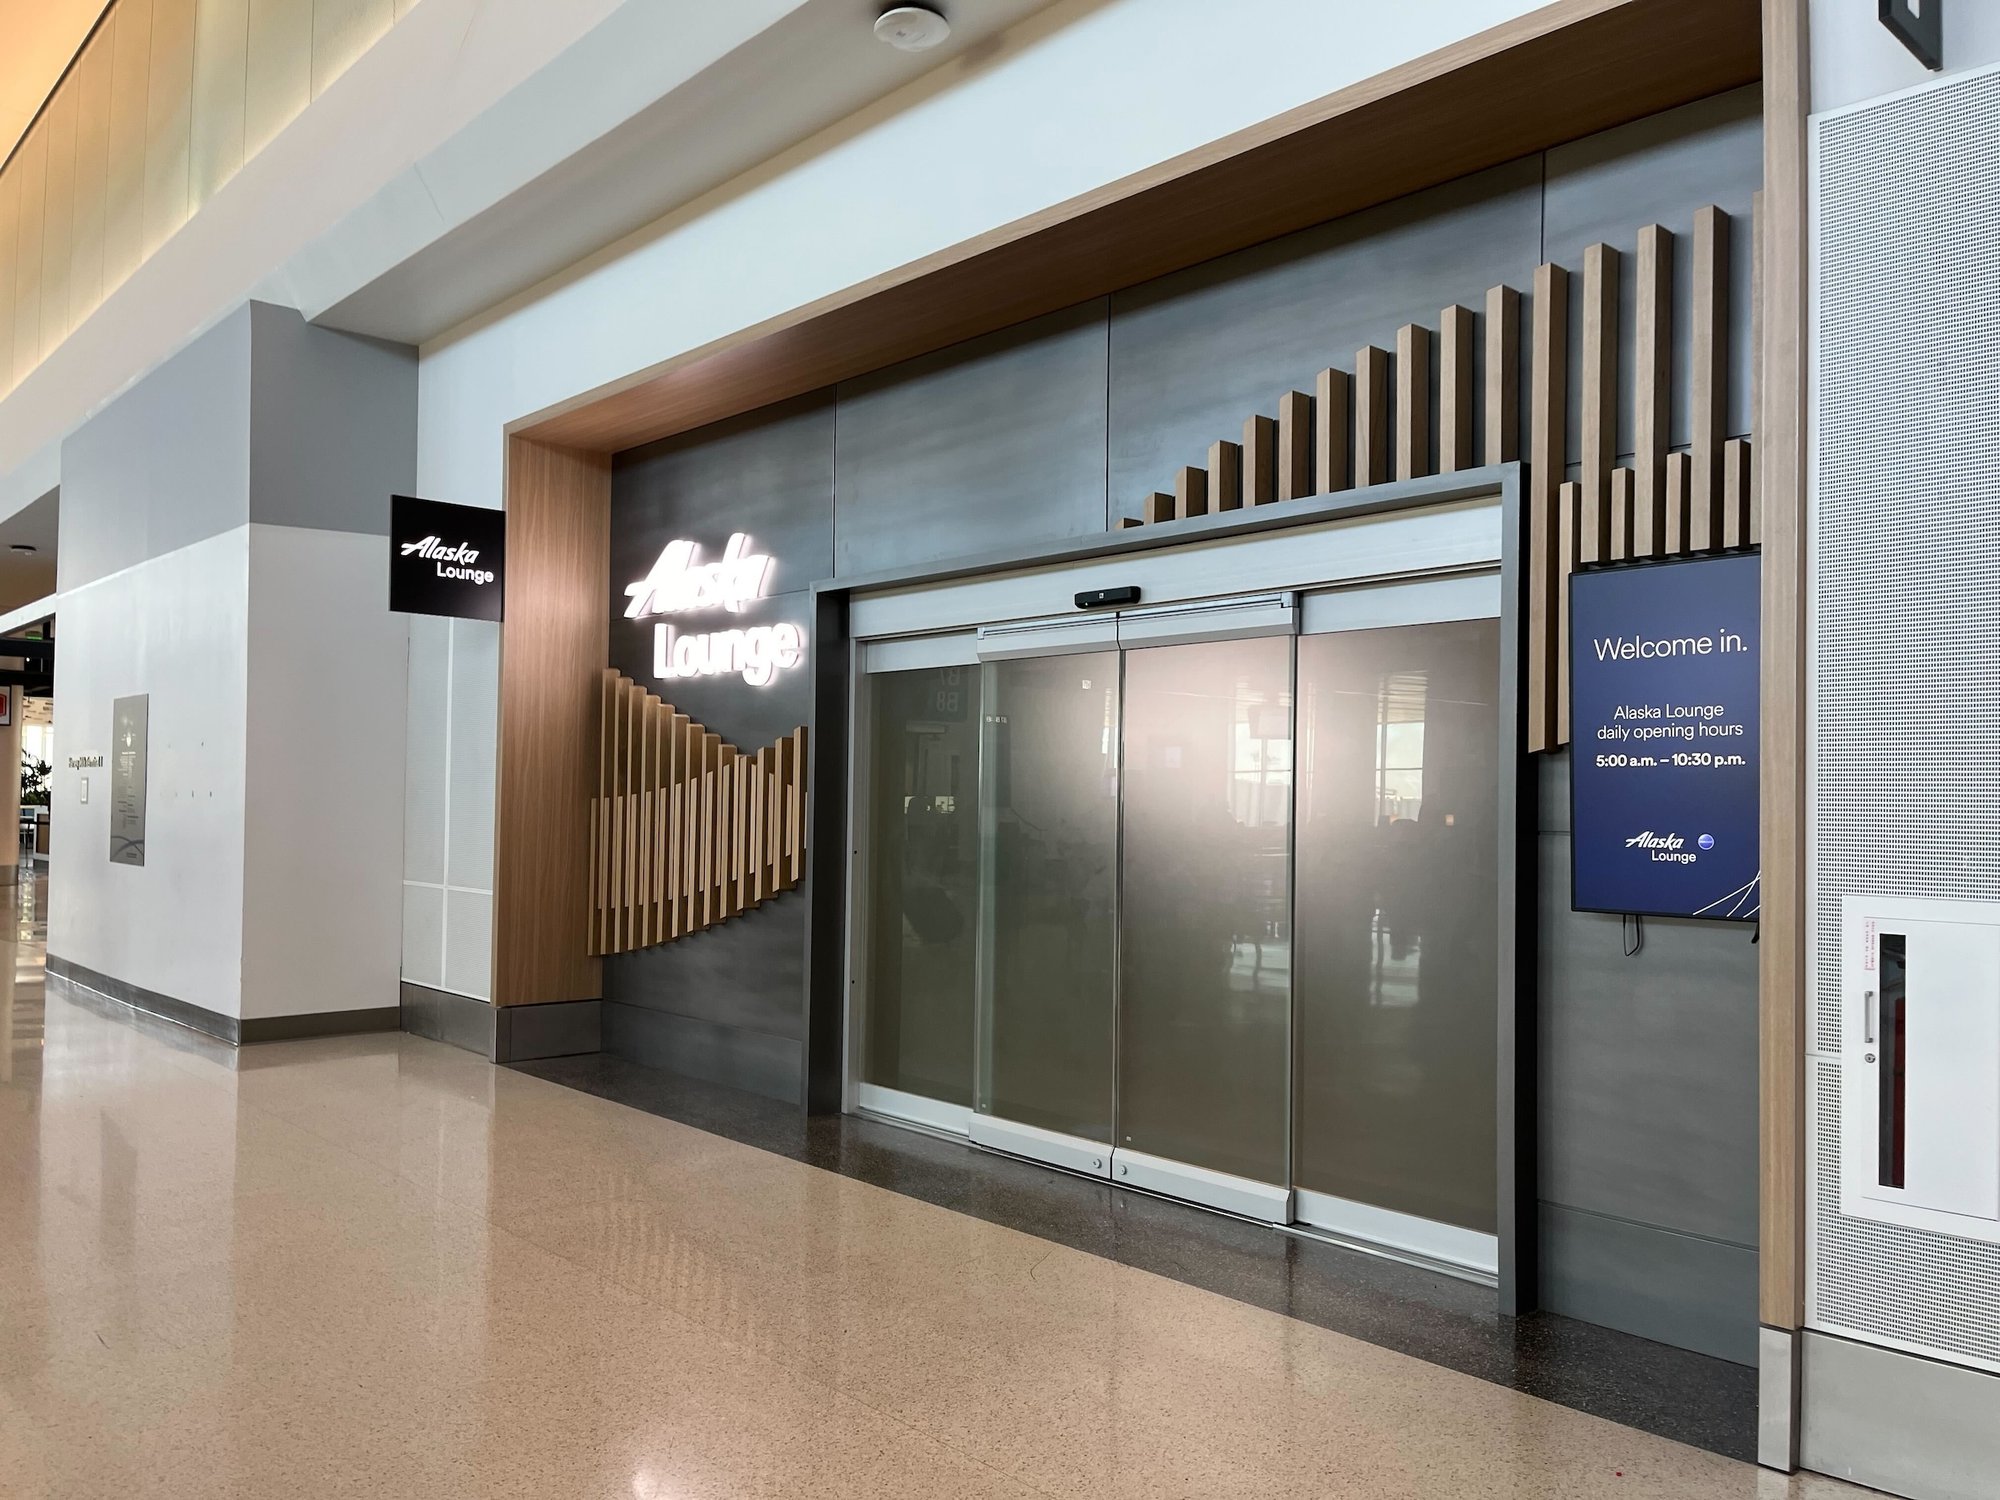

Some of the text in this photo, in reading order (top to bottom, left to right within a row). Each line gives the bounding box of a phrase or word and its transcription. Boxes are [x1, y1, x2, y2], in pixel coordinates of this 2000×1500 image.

[401, 536, 479, 565] Alaska
[437, 561, 494, 585] Lounge
[624, 532, 773, 618] Alaska
[653, 623, 802, 686] Lounge
[1593, 628, 1748, 661] Welcome in.
[1614, 704, 1724, 720] Alaska Lounge
[1597, 722, 1743, 742] daily opening hours
[1596, 754, 1627, 767] 5:00
[1629, 756, 1657, 767] a.m.
[1672, 753, 1712, 766] 10:30
[1714, 755, 1746, 768] p.m.
[1625, 831, 1684, 851] Alaska
[1651, 850, 1697, 865] Lounge
